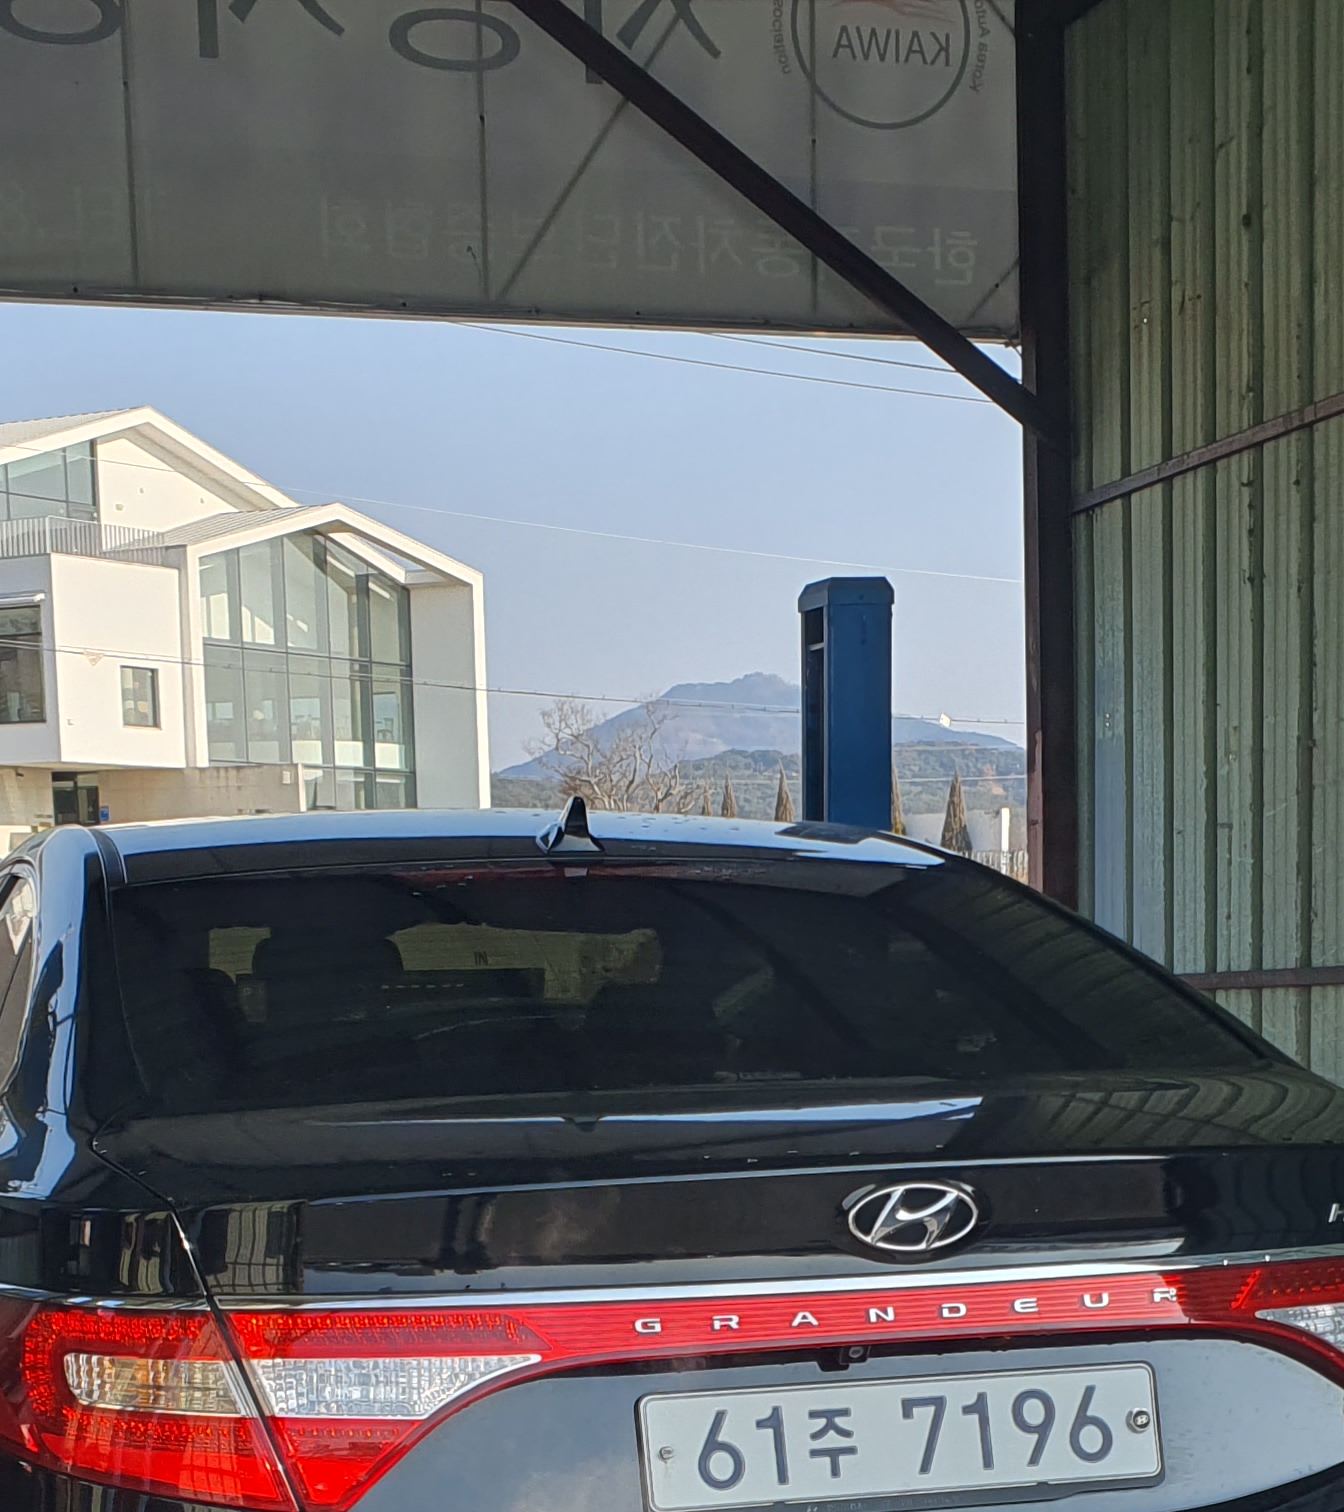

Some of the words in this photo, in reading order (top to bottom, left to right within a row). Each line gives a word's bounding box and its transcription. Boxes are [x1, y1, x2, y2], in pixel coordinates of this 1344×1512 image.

[633, 1286, 1178, 1334] GRANDEUR
[697, 1405, 858, 1490] 61주
[900, 1383, 1114, 1475] 7196
